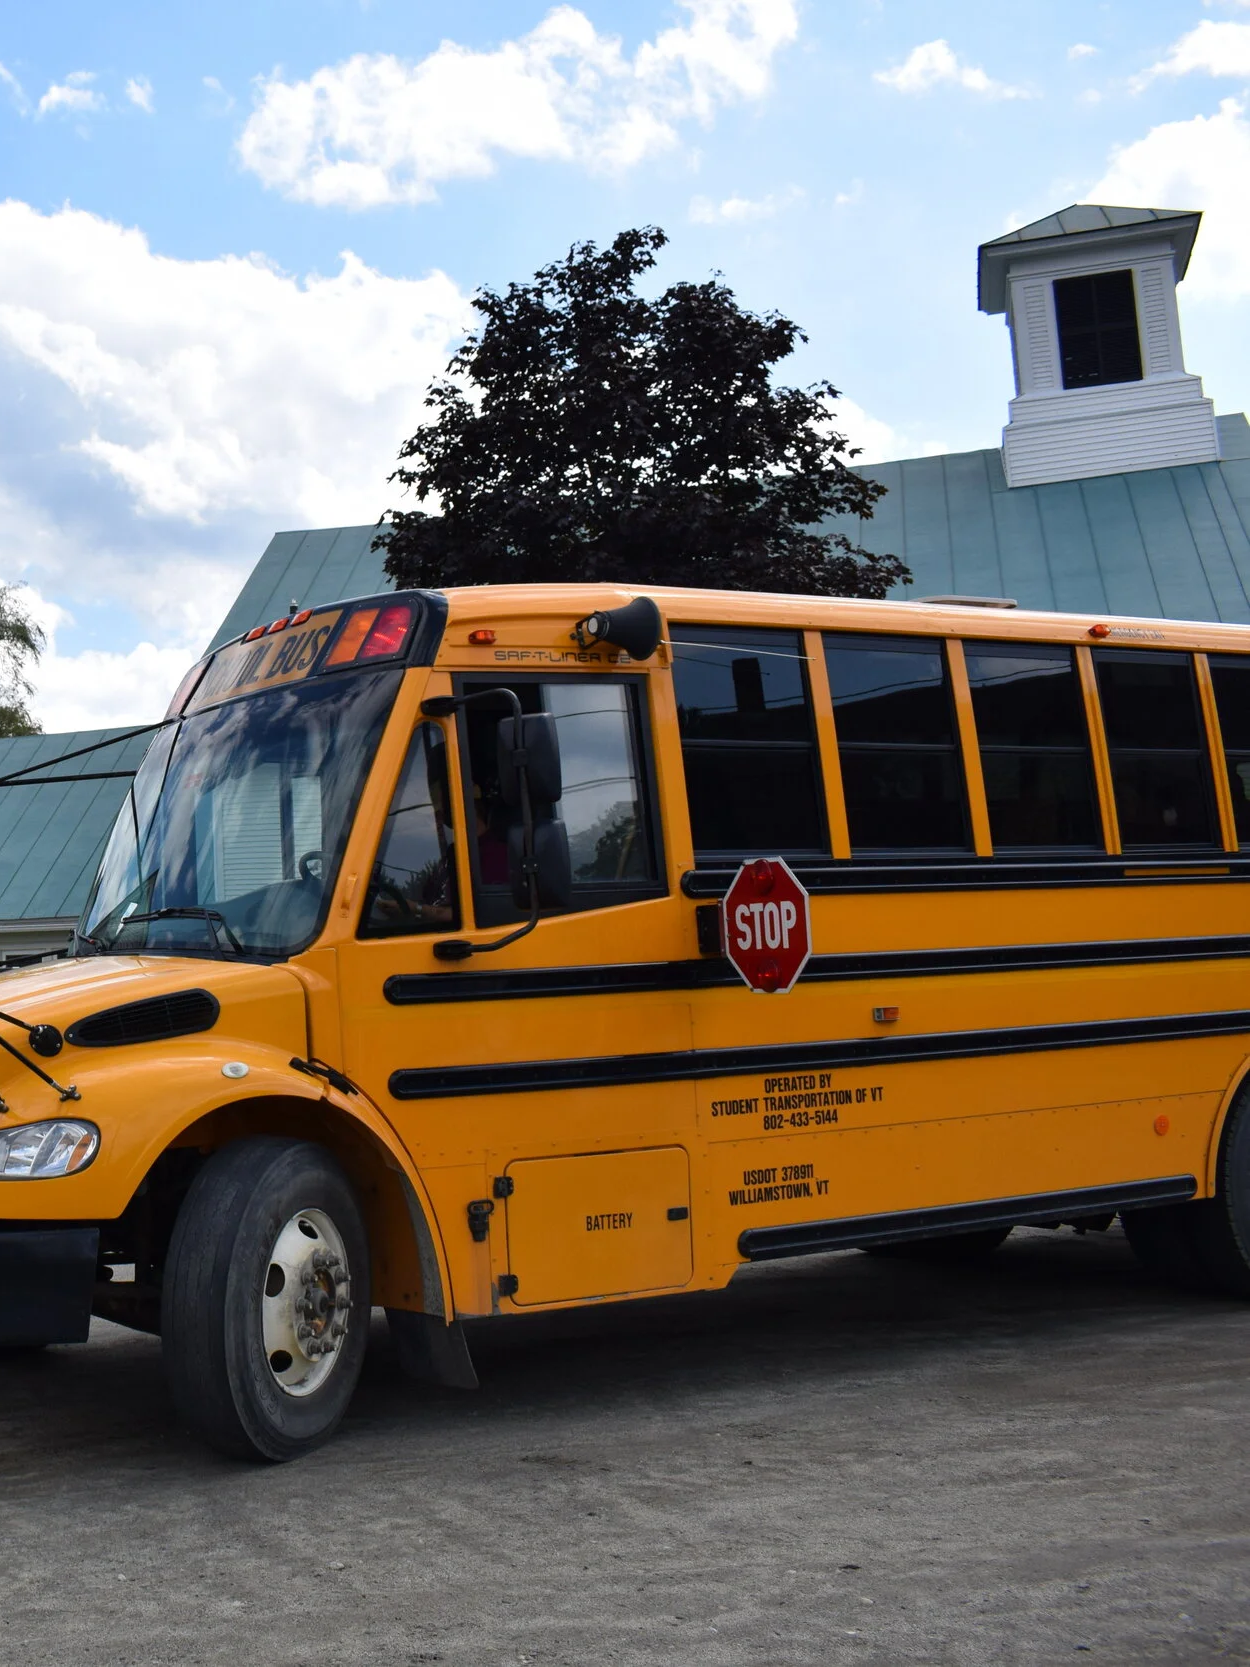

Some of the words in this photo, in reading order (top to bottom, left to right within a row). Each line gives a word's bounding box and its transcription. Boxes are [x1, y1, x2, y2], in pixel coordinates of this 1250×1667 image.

[200, 641, 273, 699] OOL
[265, 625, 331, 679] BUS
[494, 650, 602, 663] SAF-T-LINER
[607, 653, 631, 664] C2
[735, 900, 797, 950] STOP
[764, 1075, 816, 1094] OPERATED
[819, 1073, 832, 1089] BY
[711, 1098, 759, 1117] STUDENT
[763, 1090, 852, 1112] TRANSPORTATION
[856, 1088, 867, 1103] OF
[870, 1086, 884, 1101] VT
[763, 1109, 838, 1131] 802-433-5144
[743, 1168, 777, 1186] USDOT
[781, 1163, 814, 1182] 378911
[729, 1183, 813, 1206] WILLIAMSTOWN,
[816, 1180, 830, 1196] VT
[586, 1212, 633, 1231] BATTERY
